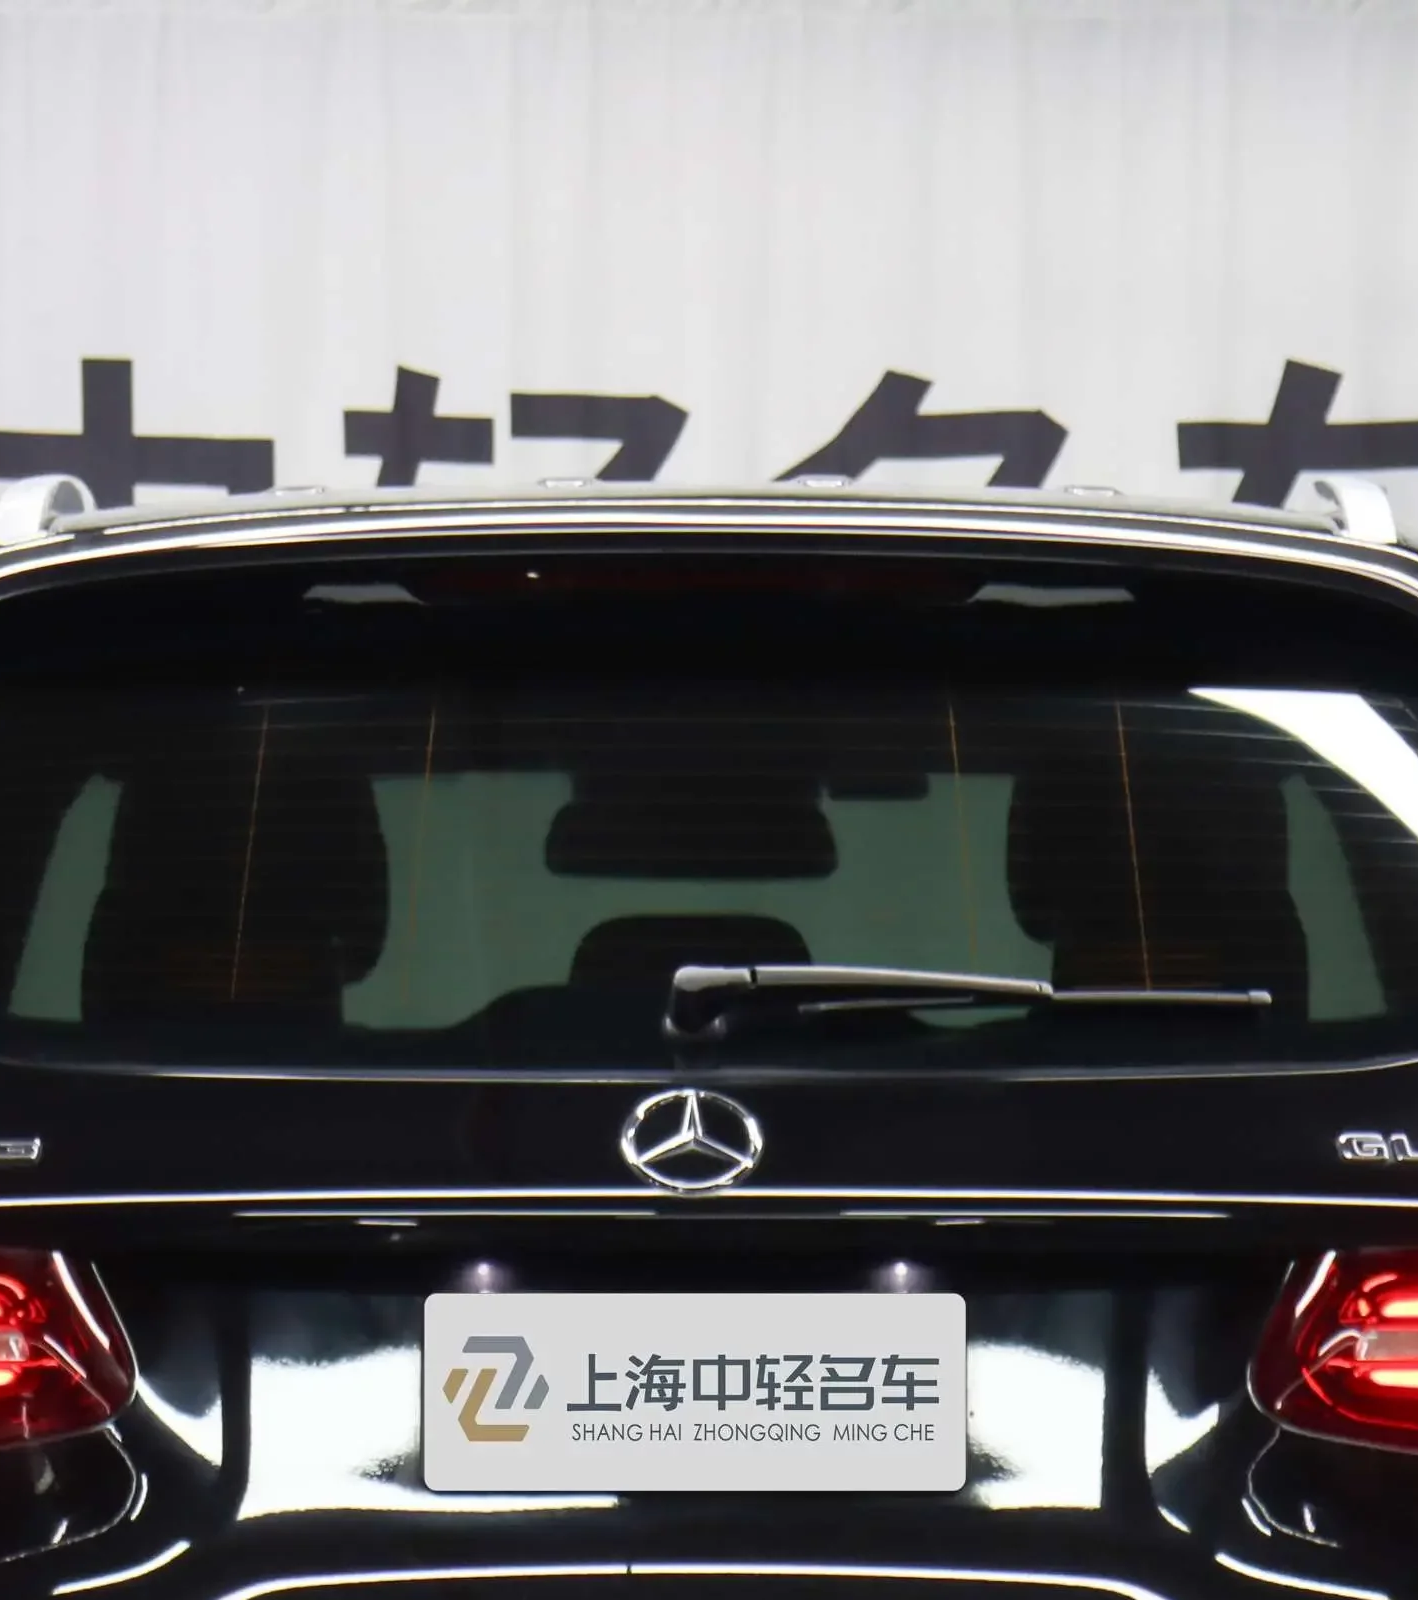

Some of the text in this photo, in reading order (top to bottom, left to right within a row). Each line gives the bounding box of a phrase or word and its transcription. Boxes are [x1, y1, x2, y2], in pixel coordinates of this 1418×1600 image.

[566, 1353, 940, 1412] 上海中轻名车
[571, 1423, 935, 1443] SHANG HAI ZHONGQING MING CHE
